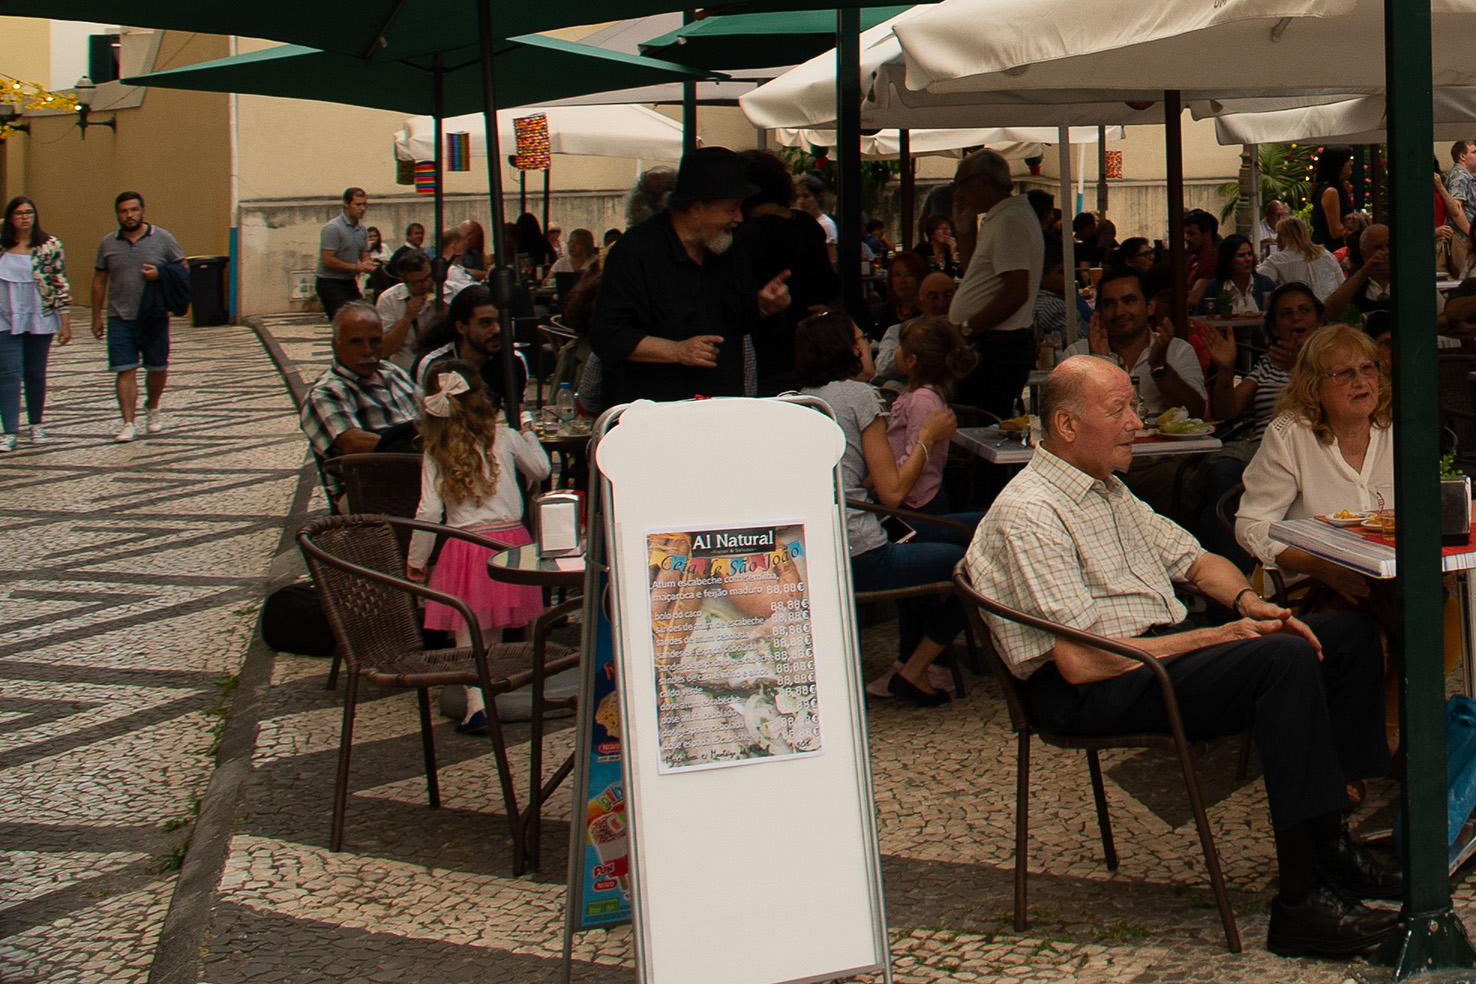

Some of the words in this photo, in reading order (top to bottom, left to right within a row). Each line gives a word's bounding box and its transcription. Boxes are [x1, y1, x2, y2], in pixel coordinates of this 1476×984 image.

[692, 534, 711, 550] Al
[716, 530, 774, 548] Natural
[661, 554, 697, 574] Ceia
[726, 559, 758, 576] São
[762, 547, 799, 571] João
[652, 580, 676, 589] Atum
[678, 576, 722, 587] escabeche
[653, 592, 694, 603] maçaroca
[696, 591, 702, 599] e
[704, 587, 728, 599] feijão
[729, 586, 762, 596] maduro
[655, 611, 672, 620] bolo
